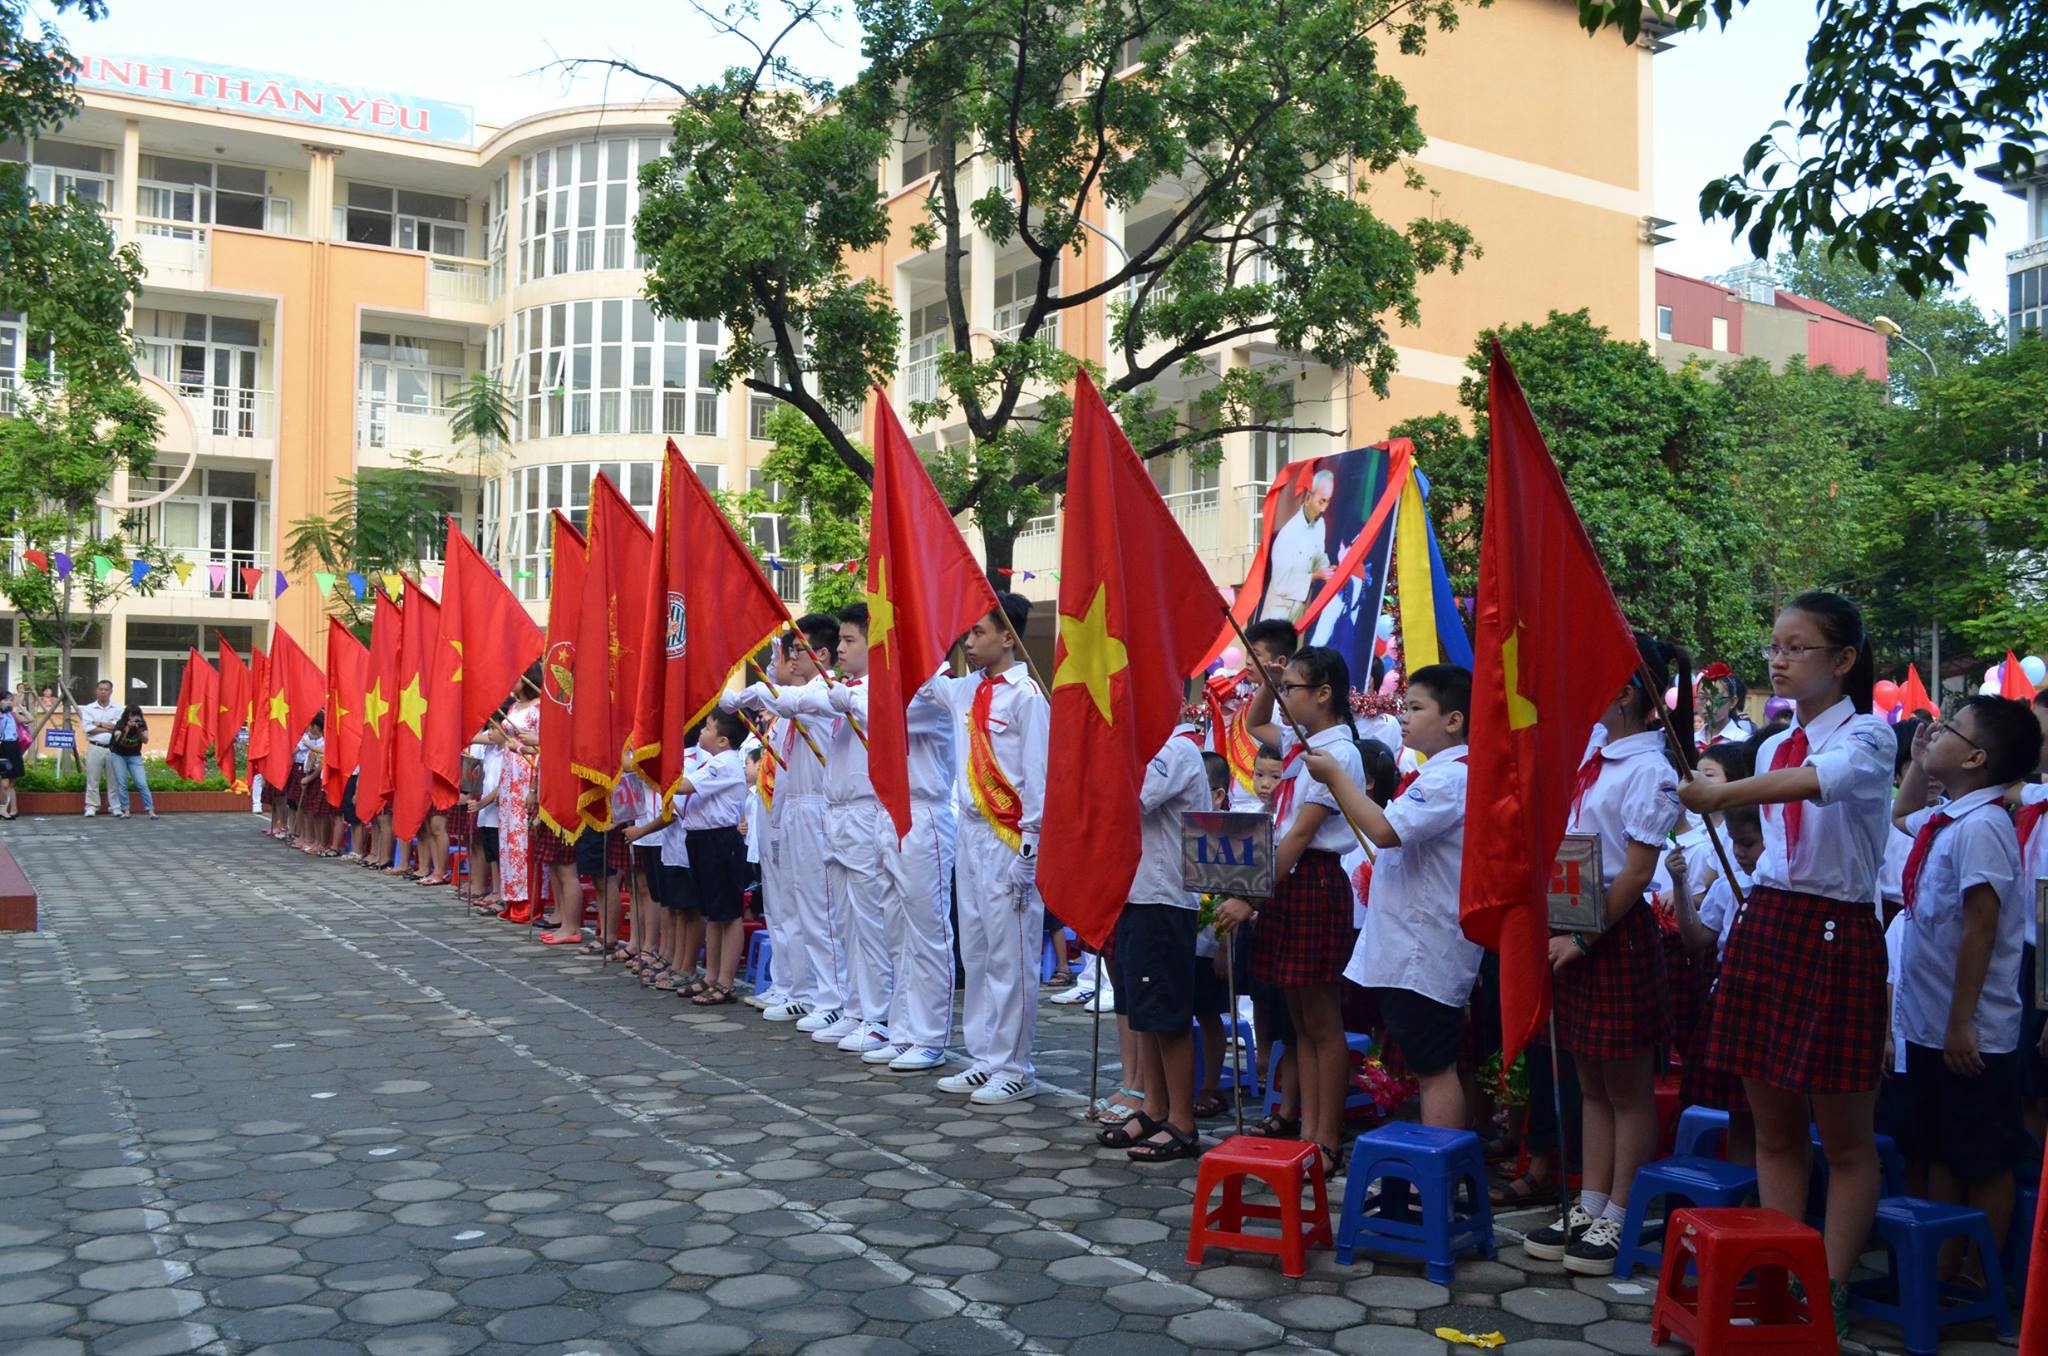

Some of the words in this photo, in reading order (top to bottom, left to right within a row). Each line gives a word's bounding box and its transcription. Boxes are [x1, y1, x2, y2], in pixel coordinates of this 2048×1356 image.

[58, 53, 173, 92] INH
[184, 69, 323, 115] THÂN
[334, 95, 430, 132] YÊU
